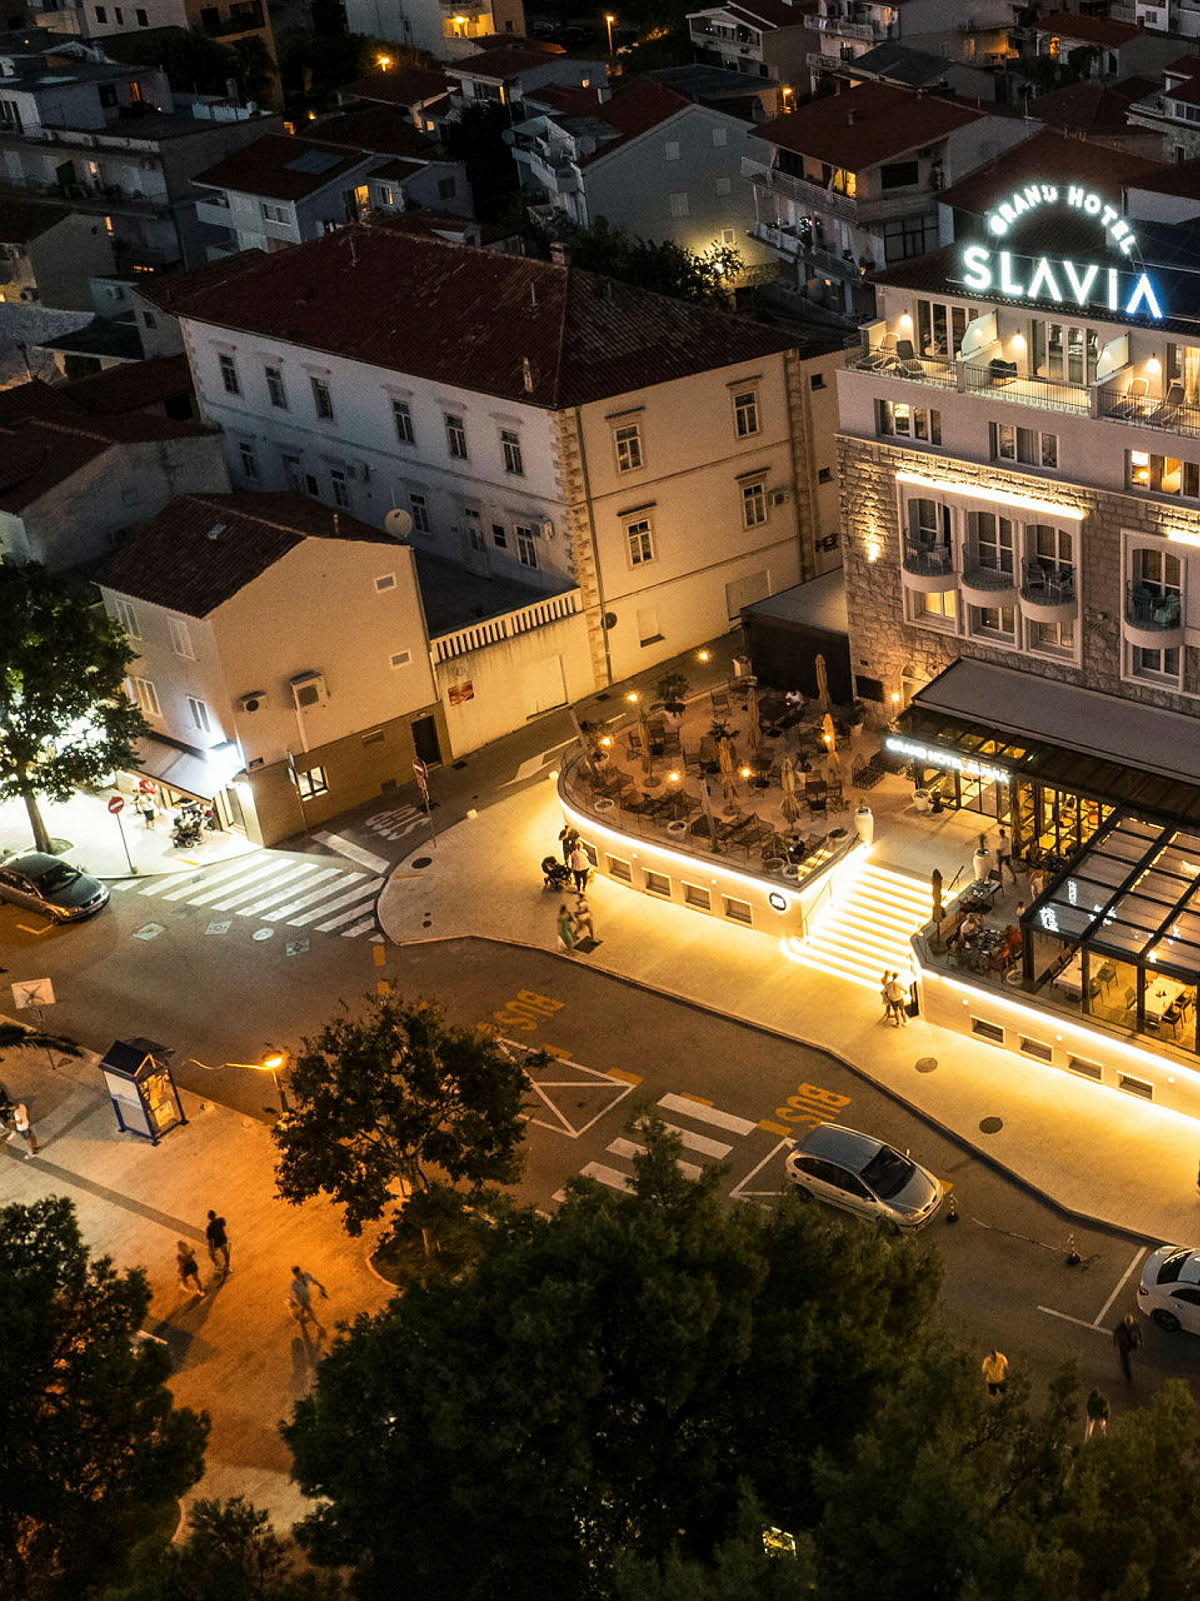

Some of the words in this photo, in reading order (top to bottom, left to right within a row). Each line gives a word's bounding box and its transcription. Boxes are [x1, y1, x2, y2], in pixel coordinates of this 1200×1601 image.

[990, 184, 1058, 235] GRAND
[1068, 186, 1136, 254] HOTEL
[963, 246, 1164, 319] SLAVIA
[886, 738, 928, 760] GRAND
[928, 749, 964, 772] HOTEL
[365, 804, 431, 841] STOP
[493, 989, 567, 1031] BUS
[775, 1082, 852, 1131] BUS
